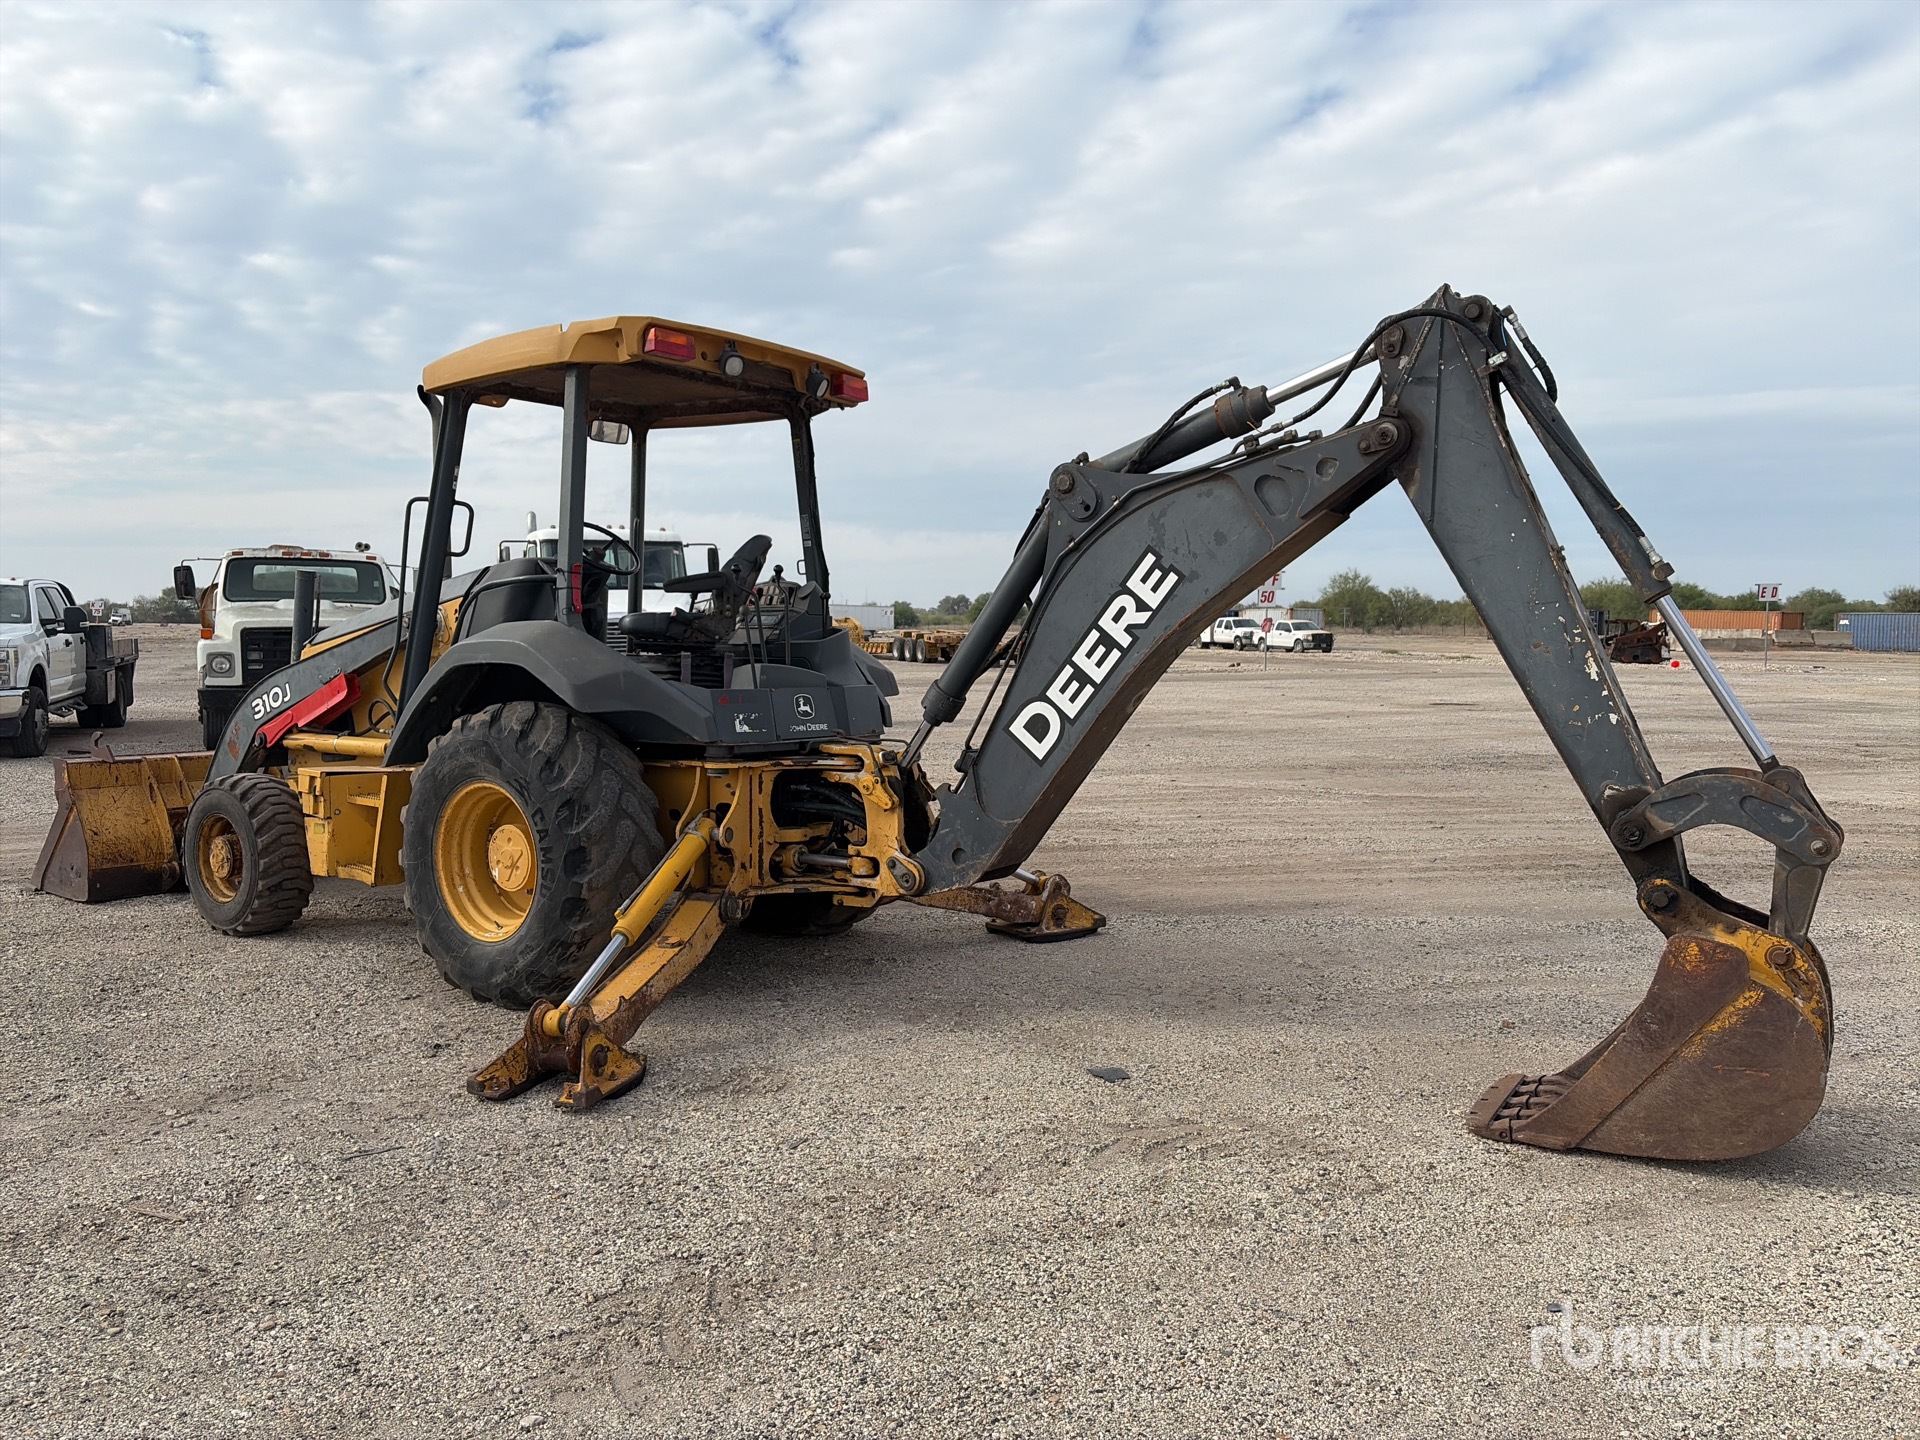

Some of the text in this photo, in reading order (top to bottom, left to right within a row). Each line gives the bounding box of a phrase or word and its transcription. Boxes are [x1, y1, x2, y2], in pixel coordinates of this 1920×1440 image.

[1272, 574, 1279, 586] F
[1260, 591, 1275, 603] 50
[1760, 587, 1778, 598] E D
[1009, 552, 1179, 760] DEERE
[251, 683, 291, 720] 310J
[807, 723, 828, 731] DEERE
